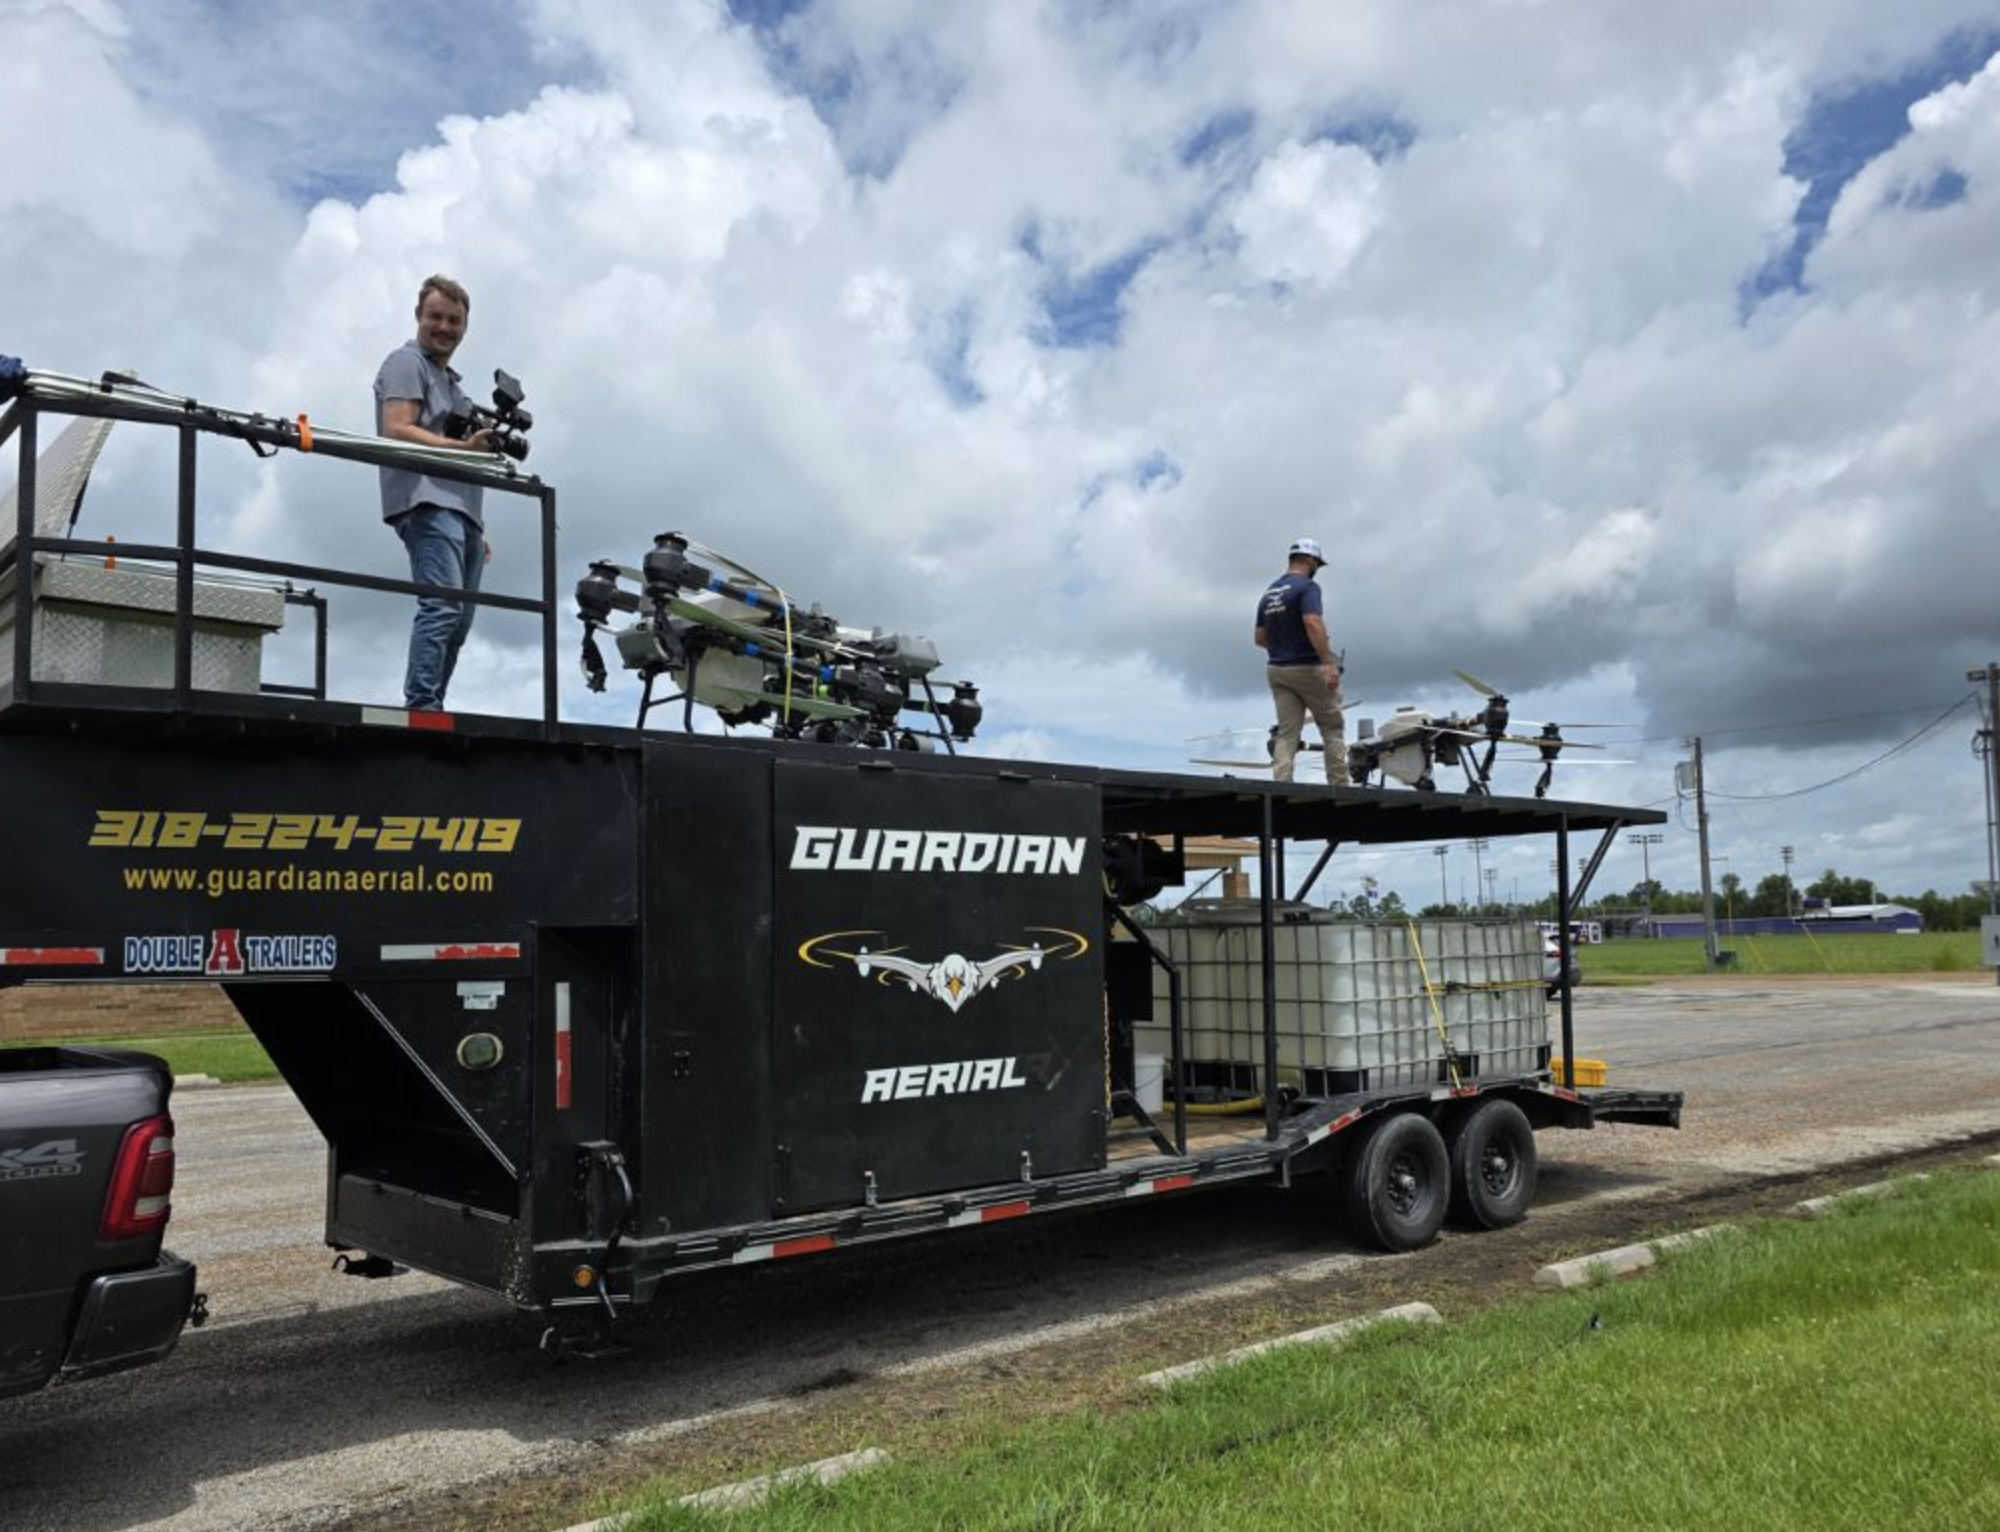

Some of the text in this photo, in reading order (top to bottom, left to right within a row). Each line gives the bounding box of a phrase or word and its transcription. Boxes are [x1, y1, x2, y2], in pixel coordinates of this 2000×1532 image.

[88, 809, 522, 852] 318-224-2419
[790, 826, 1087, 875] GUARDIAN
[124, 864, 494, 897] www.guardianaerial.com
[124, 929, 336, 974] DOUBLE A TRAILERS
[861, 1057, 1026, 1103] AERIAL
